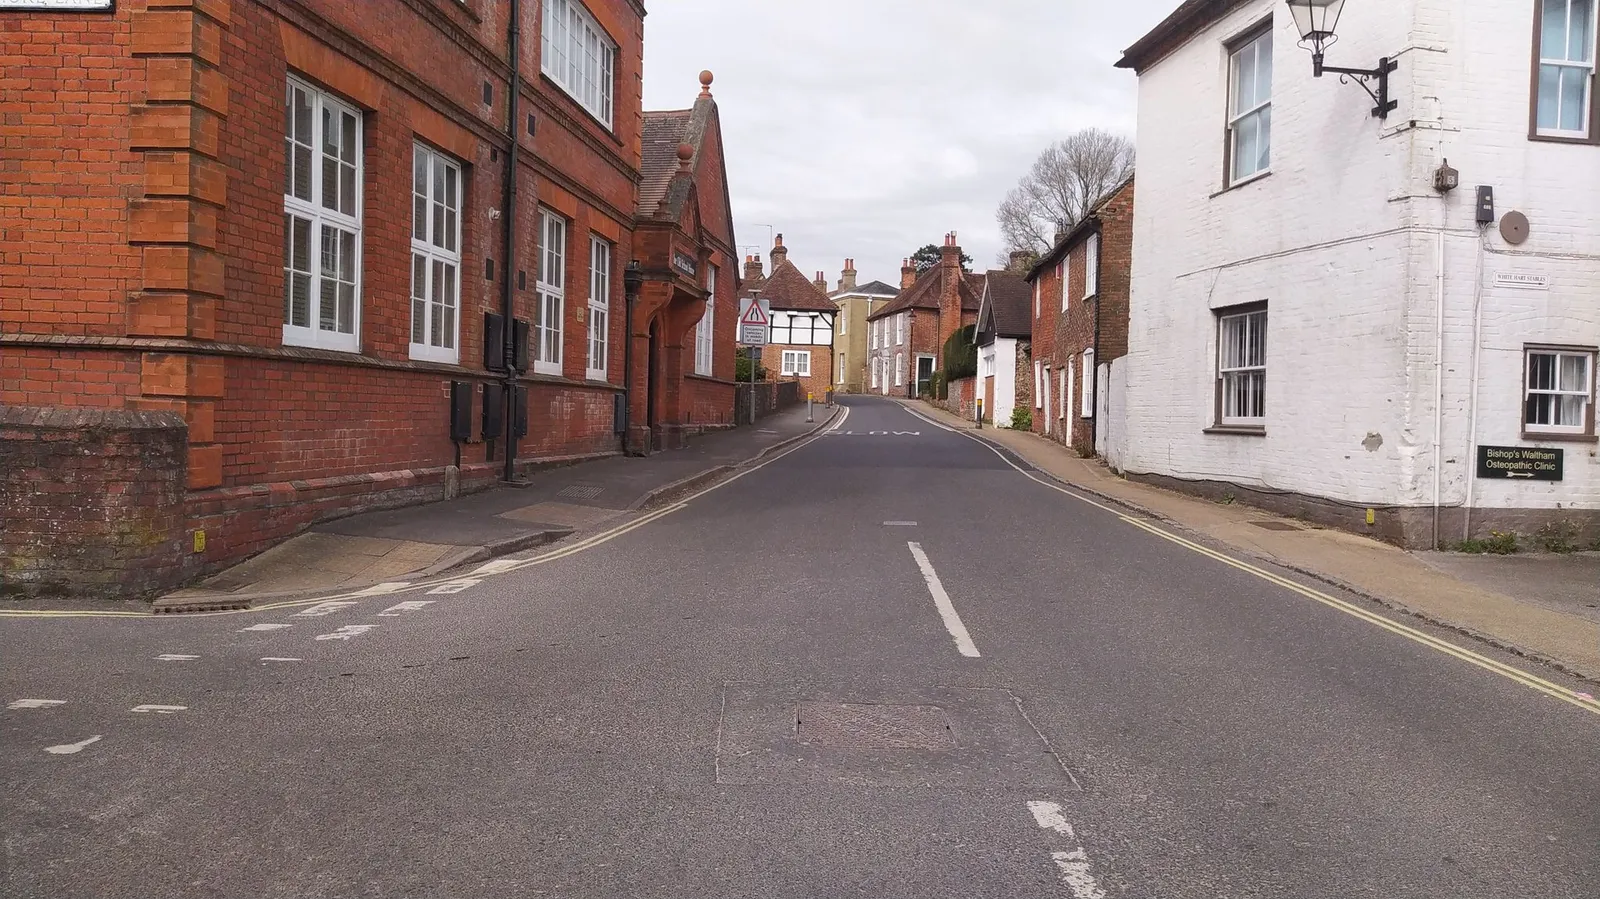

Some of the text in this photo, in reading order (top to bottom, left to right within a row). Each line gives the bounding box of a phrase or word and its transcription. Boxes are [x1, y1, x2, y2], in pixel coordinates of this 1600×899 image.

[1487, 449, 1555, 460] Bishop's Waltham
[1486, 460, 1556, 471] Osteopathic Clinic
